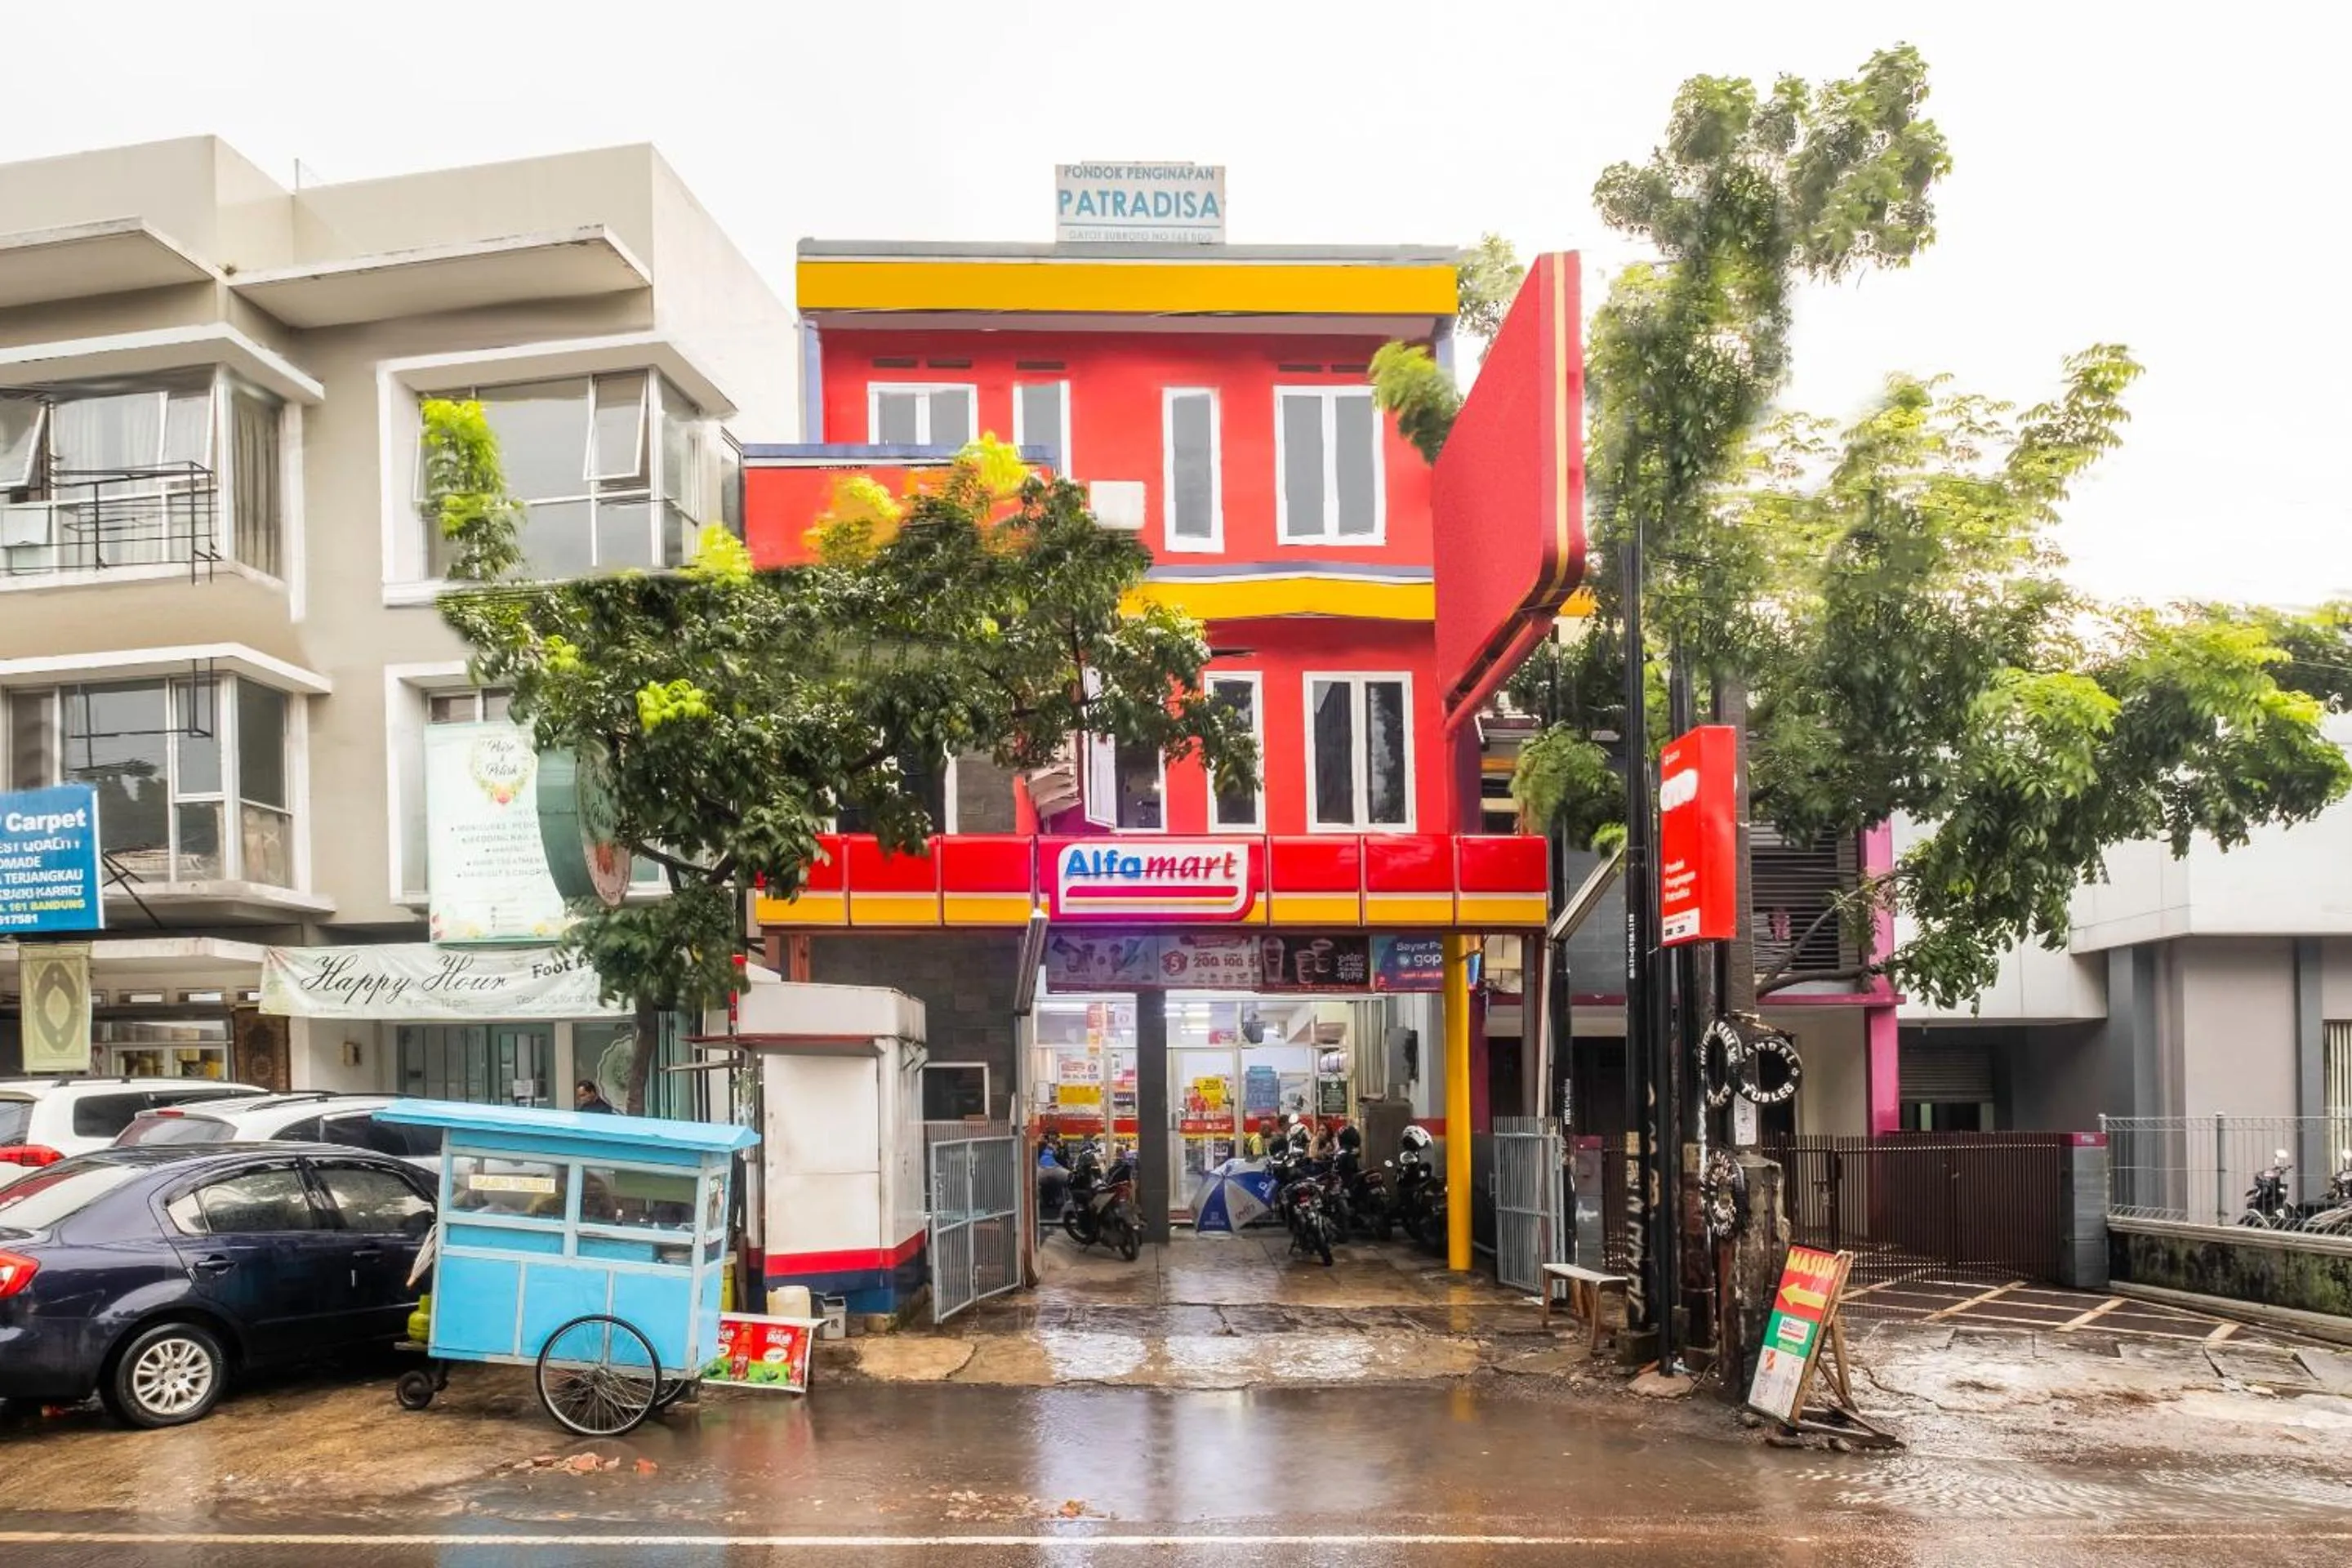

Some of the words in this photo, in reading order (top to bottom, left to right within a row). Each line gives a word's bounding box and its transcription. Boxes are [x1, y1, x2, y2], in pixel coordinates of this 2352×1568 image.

[1064, 166, 1123, 179] PONDOK
[1127, 167, 1214, 180] PENGINAPAN
[1058, 189, 1220, 219] PATRADISA
[6, 808, 87, 834] Carpet
[1064, 848, 1237, 880] Alfamart
[532, 960, 572, 979] Foot
[1414, 954, 1444, 967] gop
[301, 952, 410, 1005] Happy
[421, 952, 510, 992] Hour
